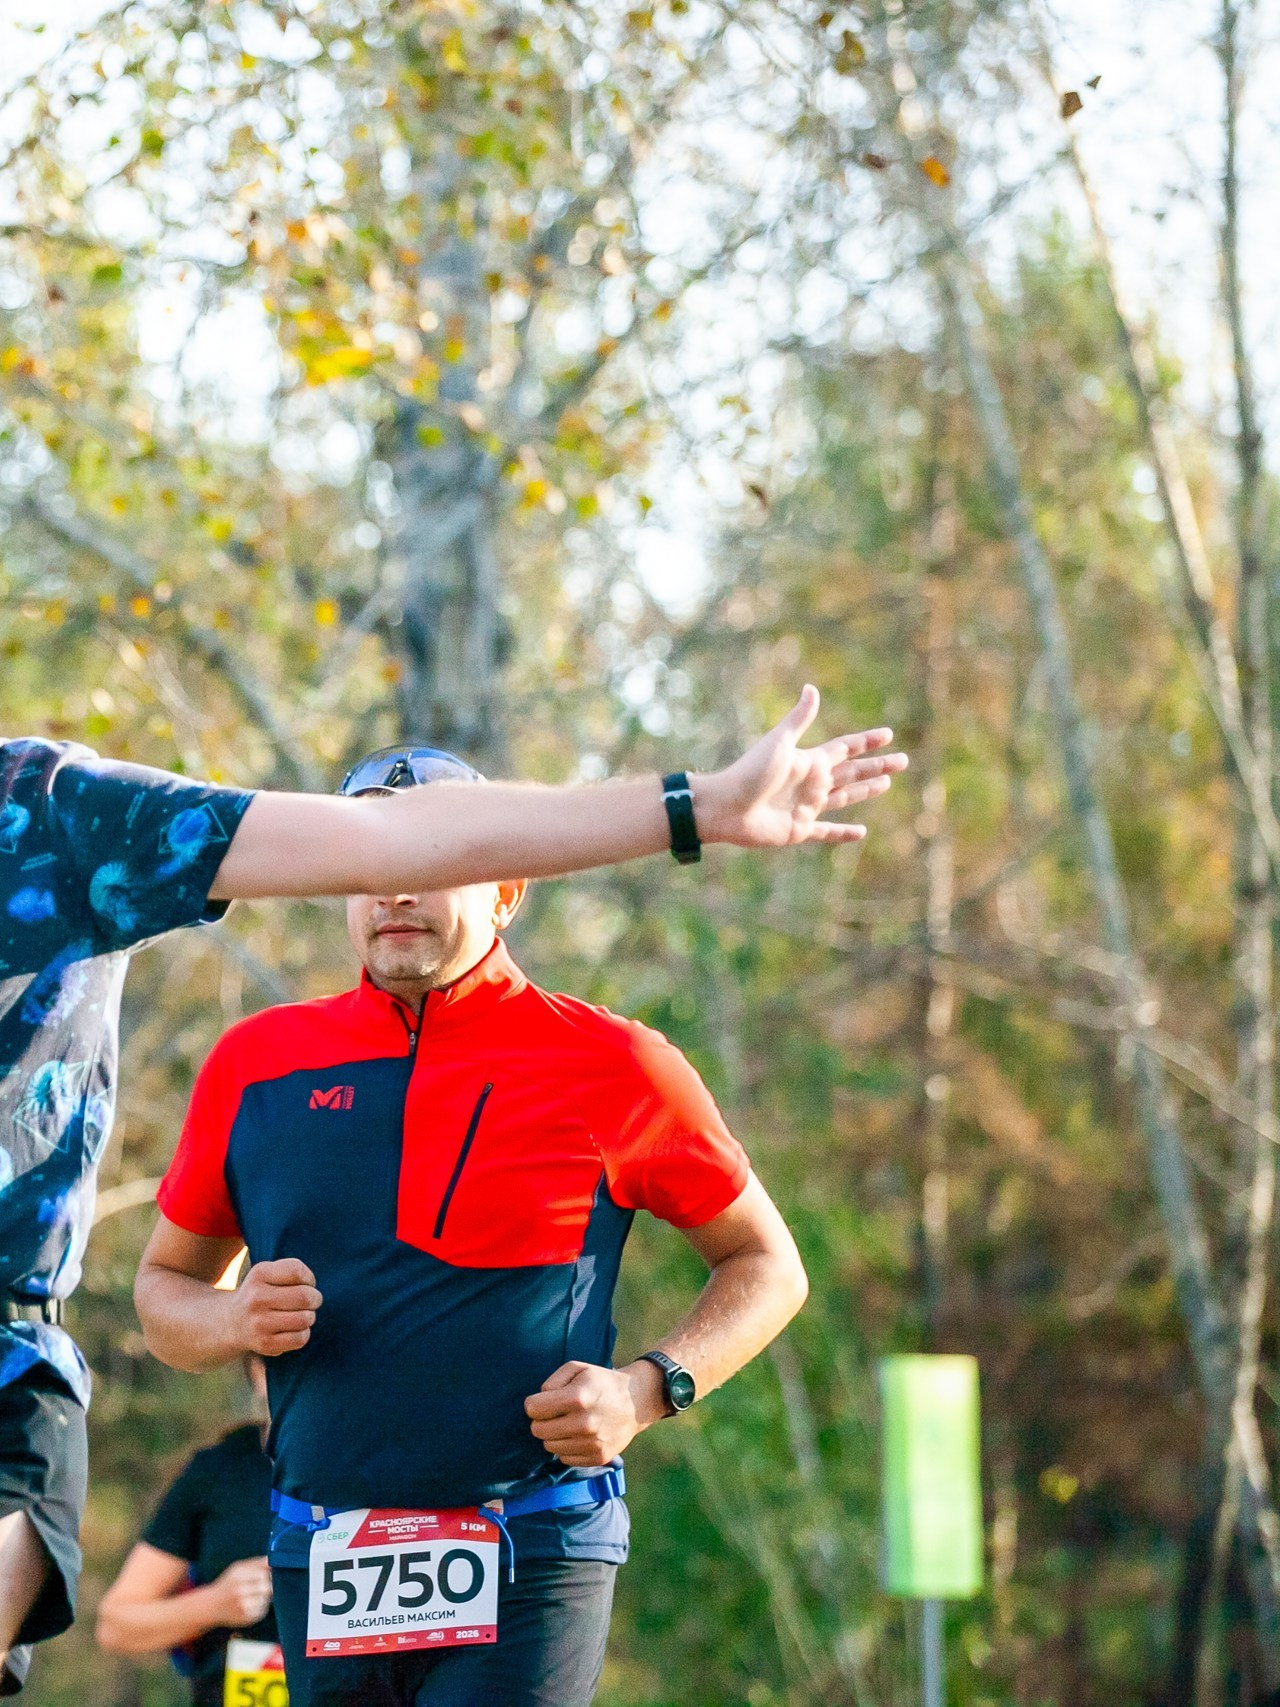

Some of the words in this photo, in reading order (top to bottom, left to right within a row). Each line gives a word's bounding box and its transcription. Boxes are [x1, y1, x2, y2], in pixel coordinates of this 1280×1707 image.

[369, 1515, 437, 1528] КРАСНОЯРСКИЕ
[387, 1525, 418, 1534] МОСТЫ
[461, 1522, 467, 1530] 5
[469, 1523, 486, 1532] КМ
[326, 1532, 348, 1541] СБЕР
[321, 1548, 485, 1616] 5750
[347, 1614, 405, 1629] ВАСИЛЬЕВ
[407, 1609, 456, 1623] МАКСИМ
[456, 1629, 480, 1639] 2026
